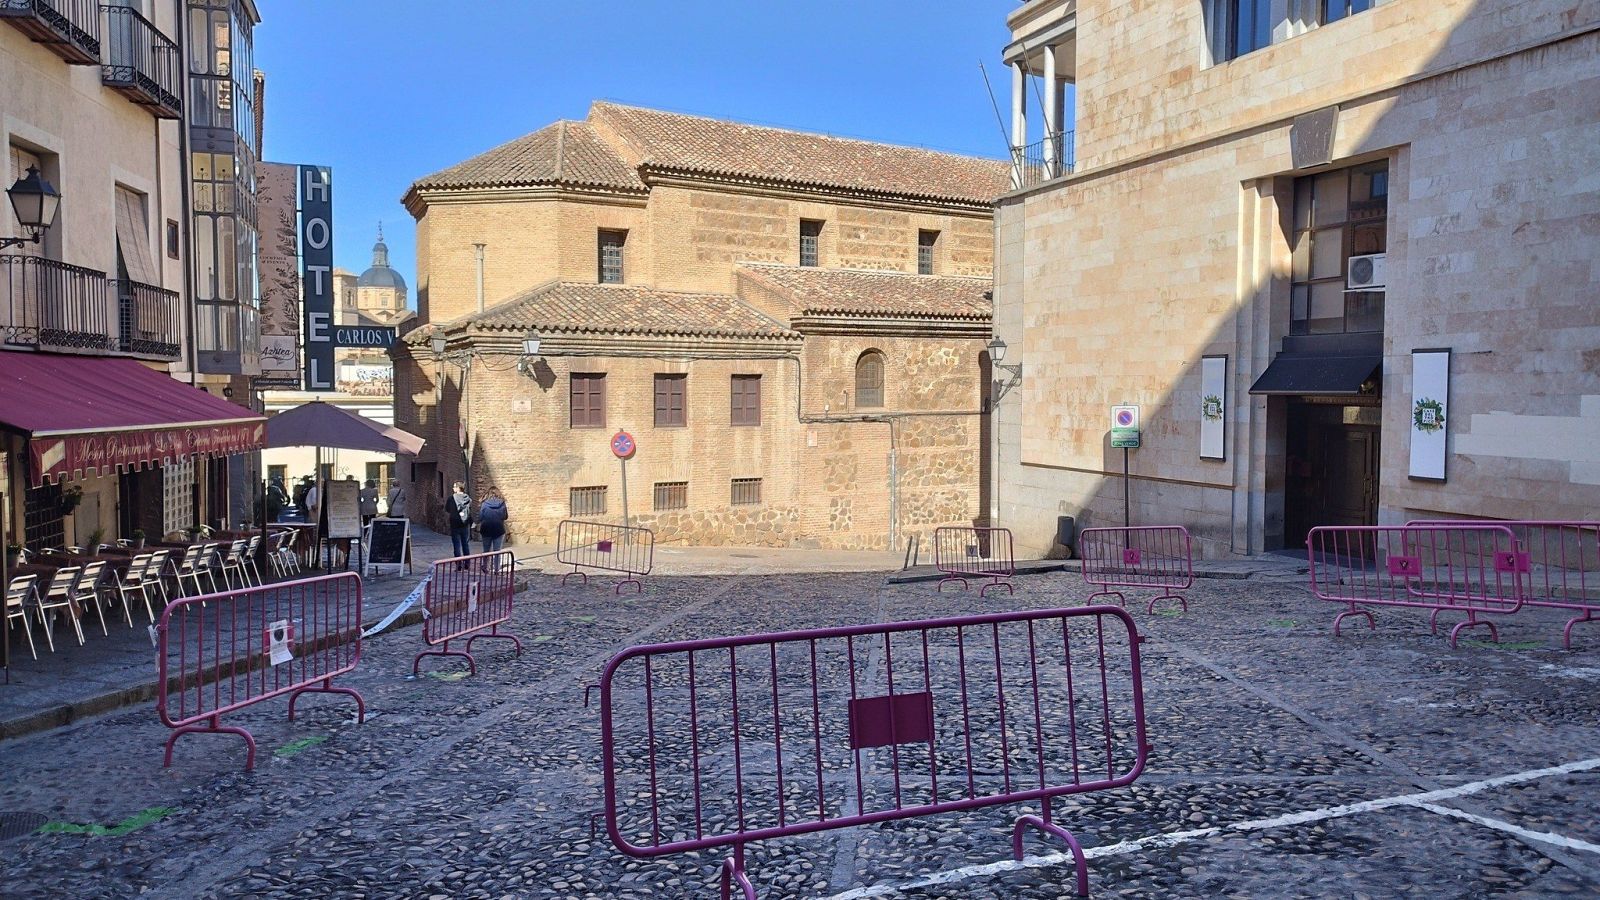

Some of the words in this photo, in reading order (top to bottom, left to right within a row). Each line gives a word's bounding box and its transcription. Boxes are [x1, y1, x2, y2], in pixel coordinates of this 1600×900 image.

[305, 170, 331, 388] HOTEL
[337, 328, 382, 344] CARLOS
[387, 329, 395, 344] V
